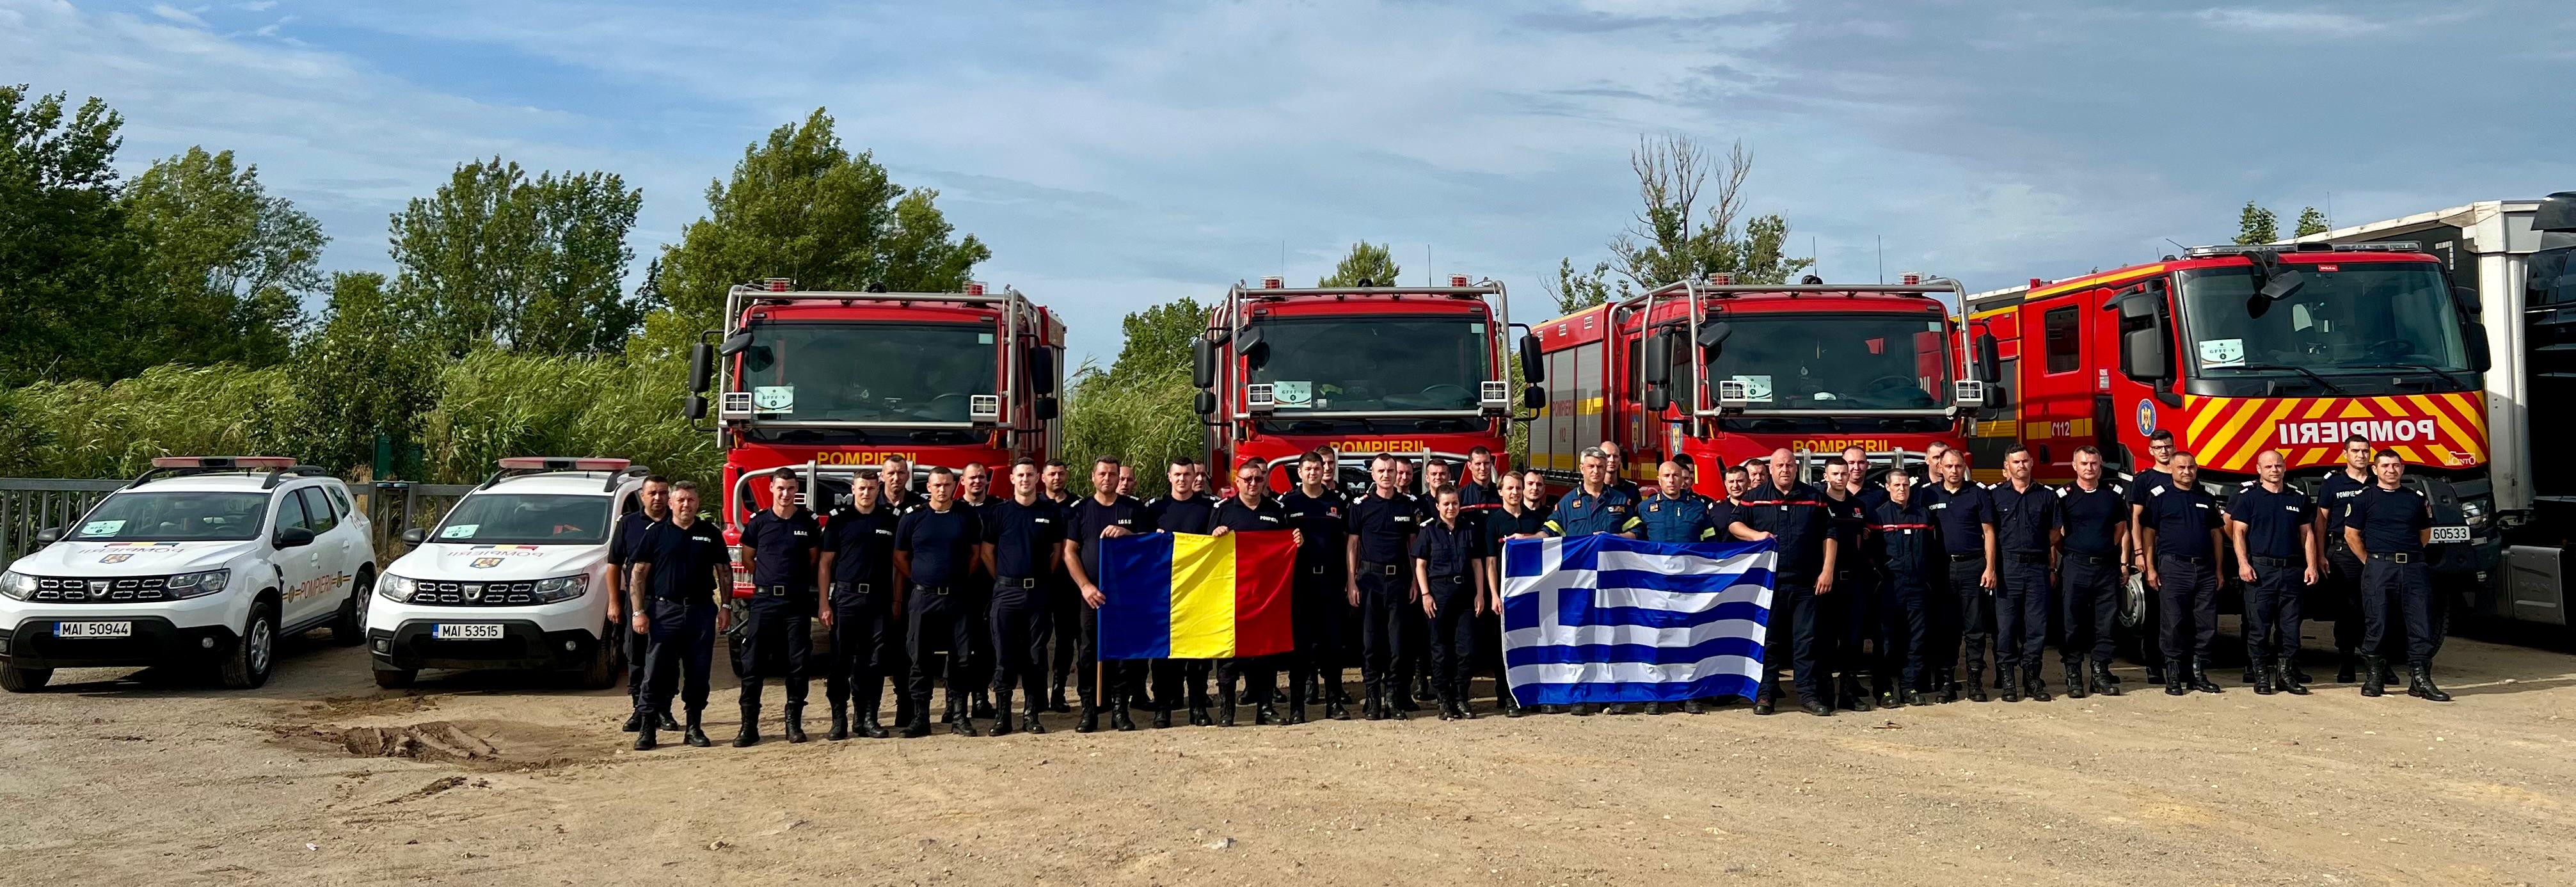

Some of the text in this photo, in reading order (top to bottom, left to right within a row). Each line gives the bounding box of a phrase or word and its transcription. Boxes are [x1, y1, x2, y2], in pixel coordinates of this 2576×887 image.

[2055, 422, 2070, 436] 112
[2433, 528, 2467, 539] 60533
[62, 623, 128, 635] MAI 50944
[442, 625, 498, 637] MAI 53515
